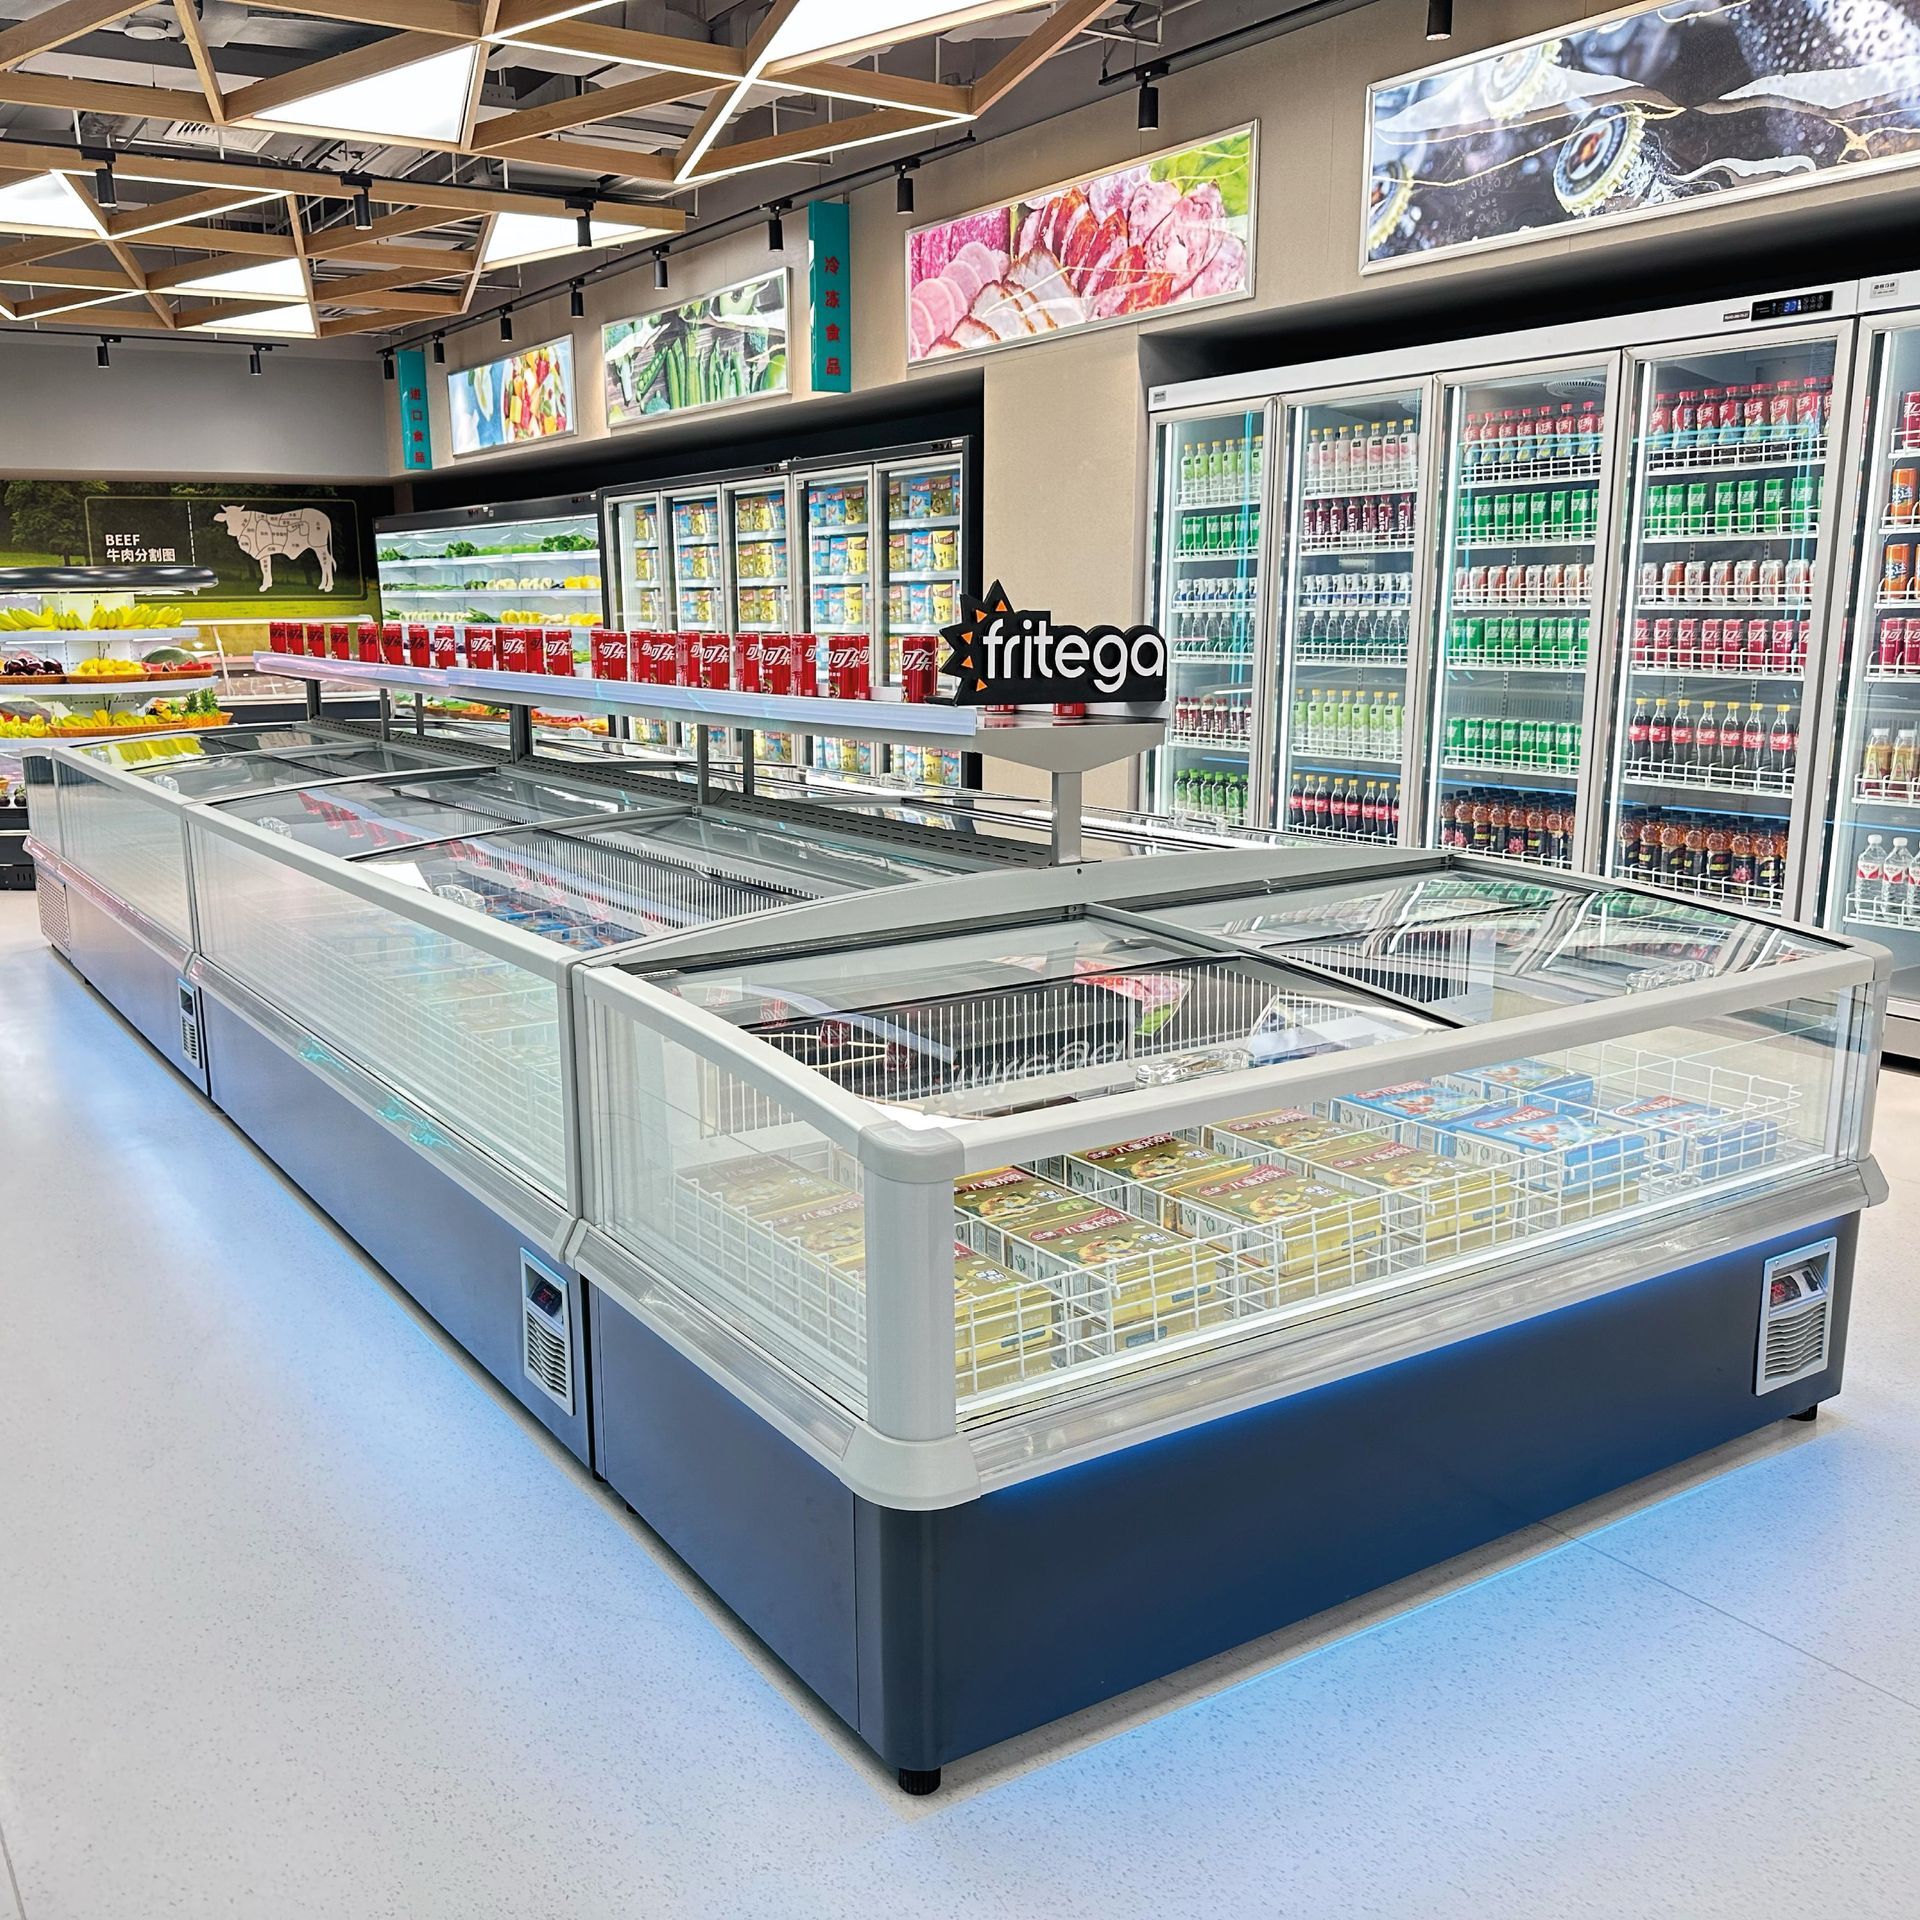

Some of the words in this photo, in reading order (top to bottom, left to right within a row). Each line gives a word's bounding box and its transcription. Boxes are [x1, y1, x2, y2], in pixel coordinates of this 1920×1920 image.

[825, 255, 841, 376] 冷冻食品
[105, 534, 140, 546] BEEF
[107, 548, 176, 562] 牛肉分割图
[983, 618, 1165, 693] fritega
